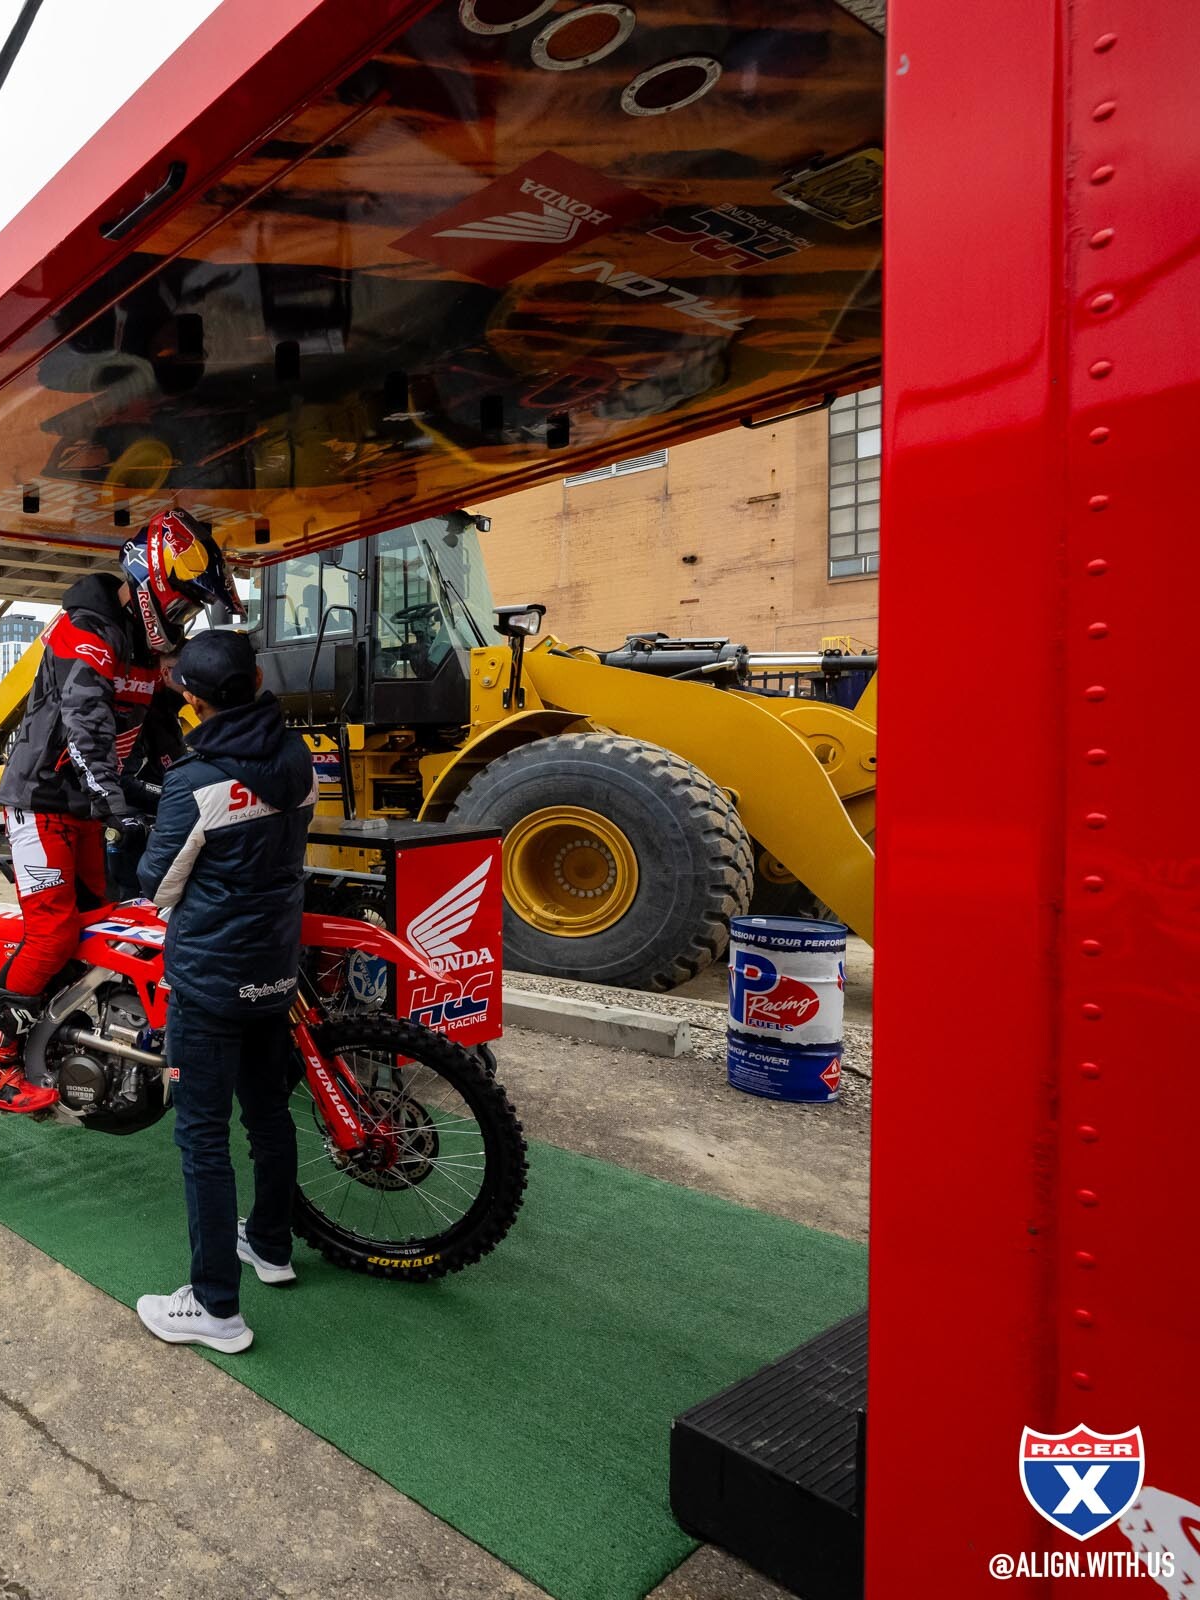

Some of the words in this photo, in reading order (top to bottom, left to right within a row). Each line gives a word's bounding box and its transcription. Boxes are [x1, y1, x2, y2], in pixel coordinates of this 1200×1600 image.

[519, 177, 612, 226] HONDA
[311, 754, 340, 764] DA
[30, 879, 65, 893] HONDA
[757, 935, 768, 943] IS
[770, 937, 803, 947] YOUR
[748, 995, 820, 1020] Racing
[448, 1013, 487, 1031] RACING
[748, 1018, 795, 1032] FUELS
[748, 1052, 790, 1066] POWER!
[66, 1085, 96, 1093] HONDA
[307, 1055, 357, 1130] DUNLOP
[367, 1254, 434, 1269] DUNLOP
